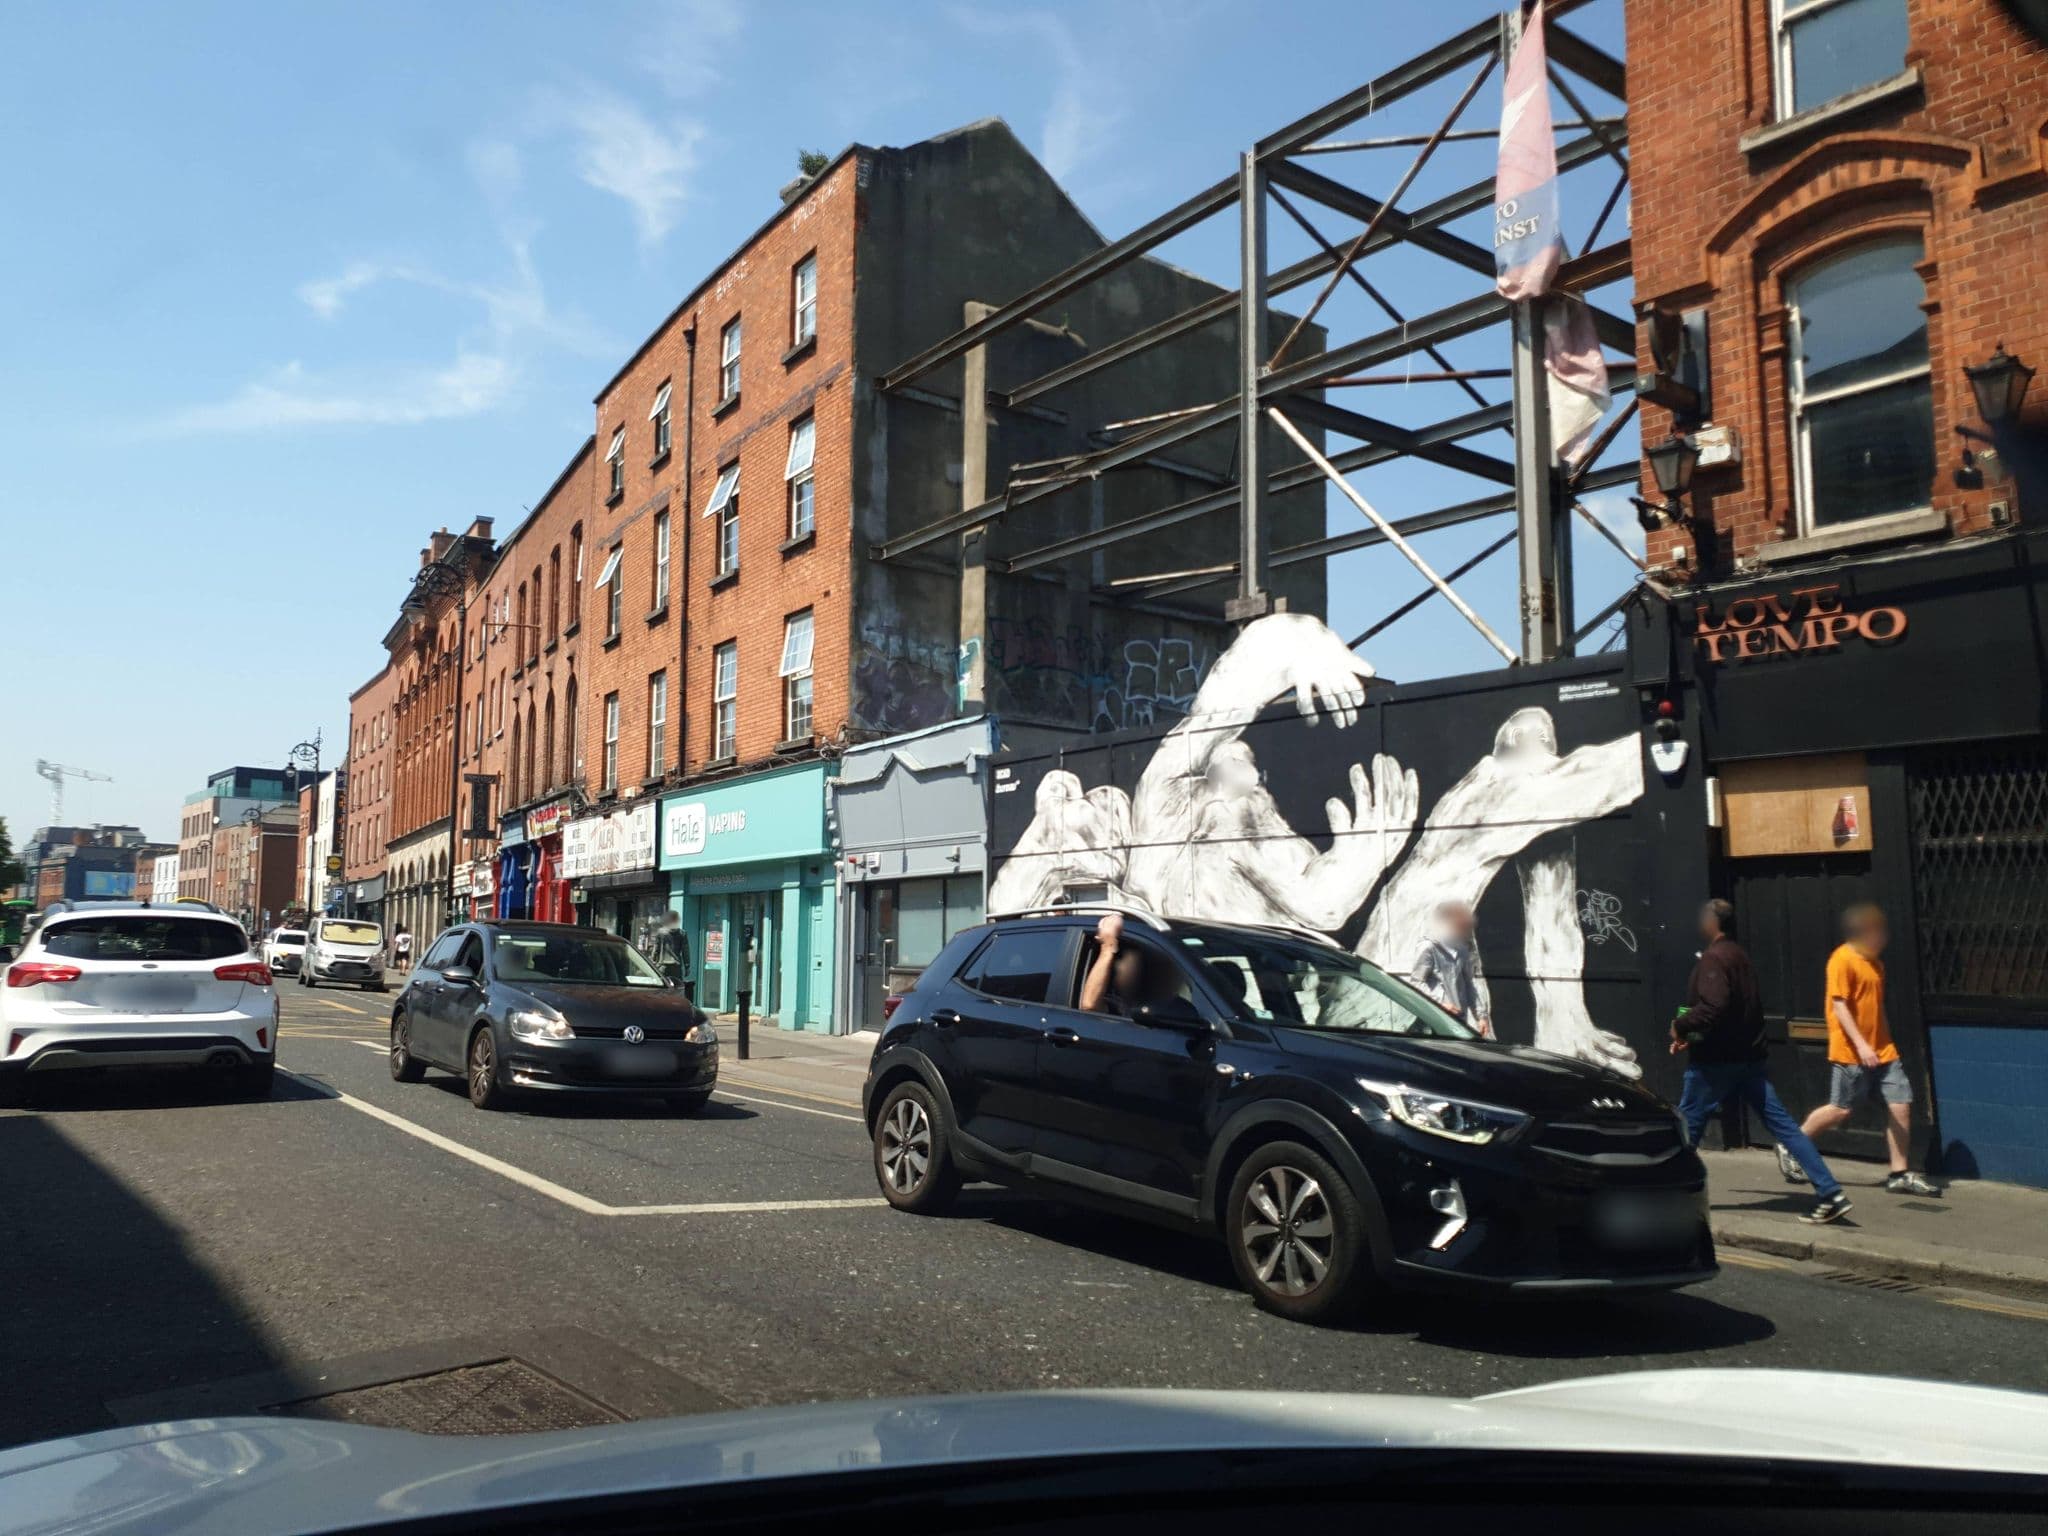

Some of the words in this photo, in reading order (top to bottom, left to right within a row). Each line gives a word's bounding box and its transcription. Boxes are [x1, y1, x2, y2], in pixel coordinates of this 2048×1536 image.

[1693, 606, 1908, 662] TEMPO
[1695, 584, 1844, 634] LOVE
[709, 809, 747, 836] VAPING
